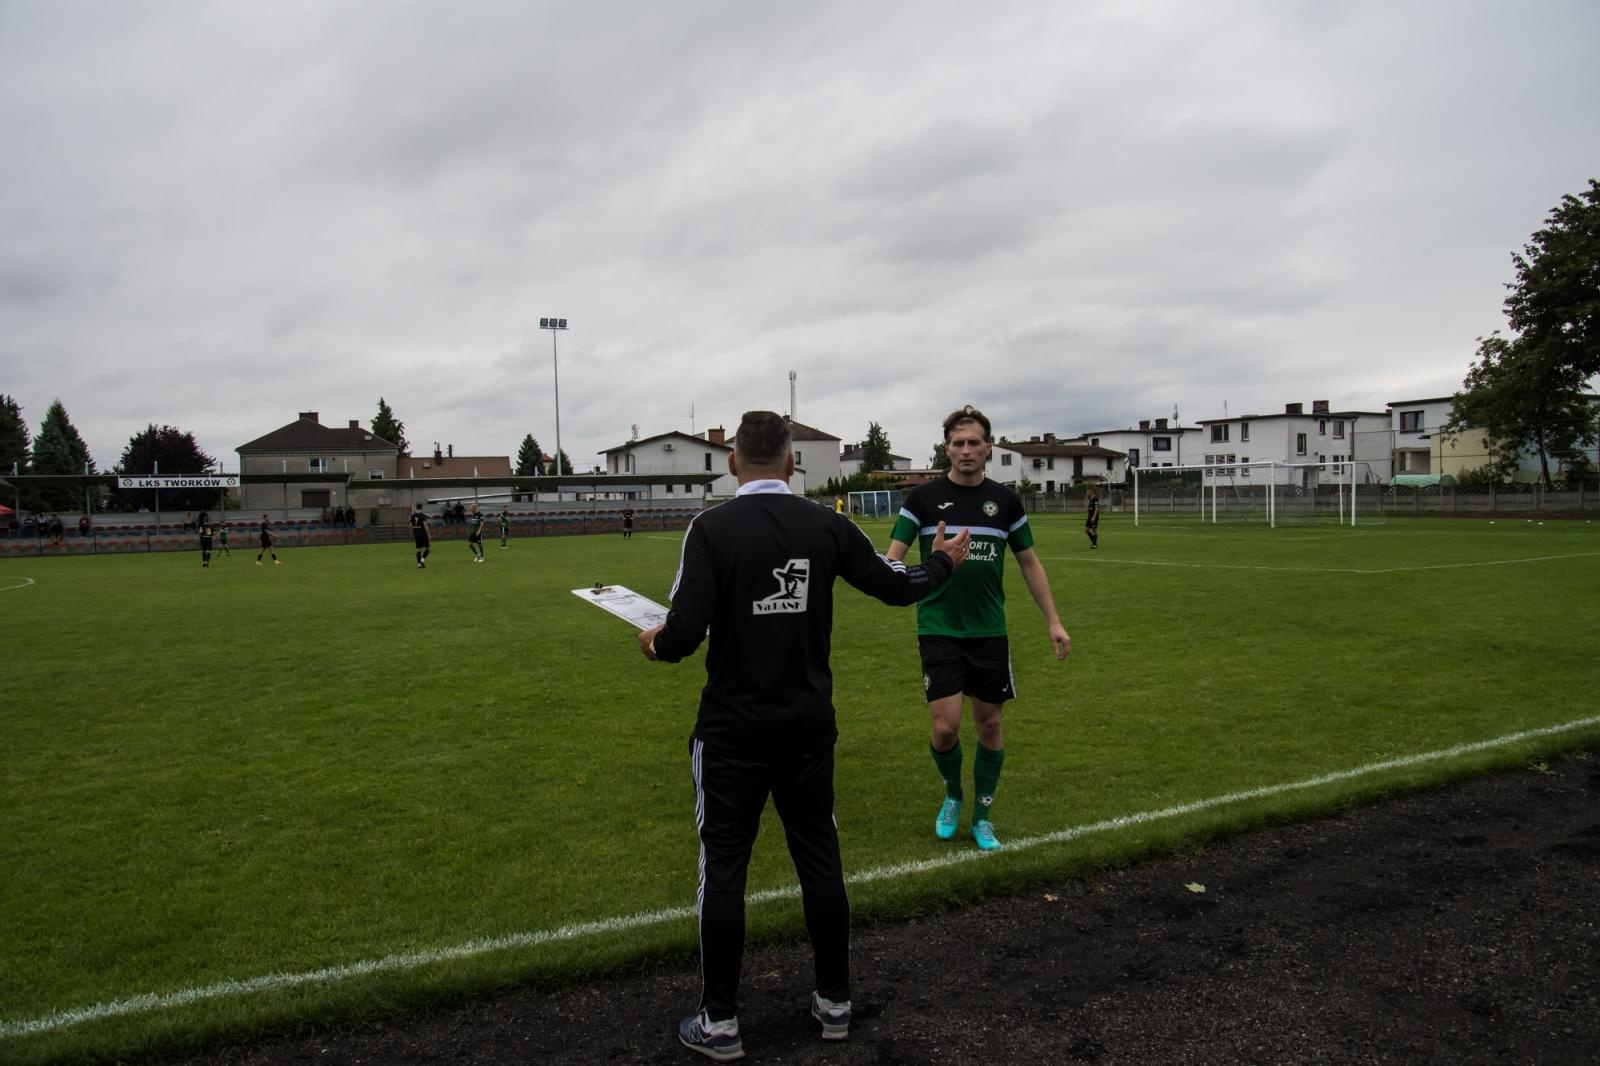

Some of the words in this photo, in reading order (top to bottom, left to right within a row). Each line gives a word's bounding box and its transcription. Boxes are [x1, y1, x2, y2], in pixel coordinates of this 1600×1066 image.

[139, 479, 160, 487] LKS
[164, 478, 221, 487] TWORKÓW
[969, 541, 990, 550] ORT
